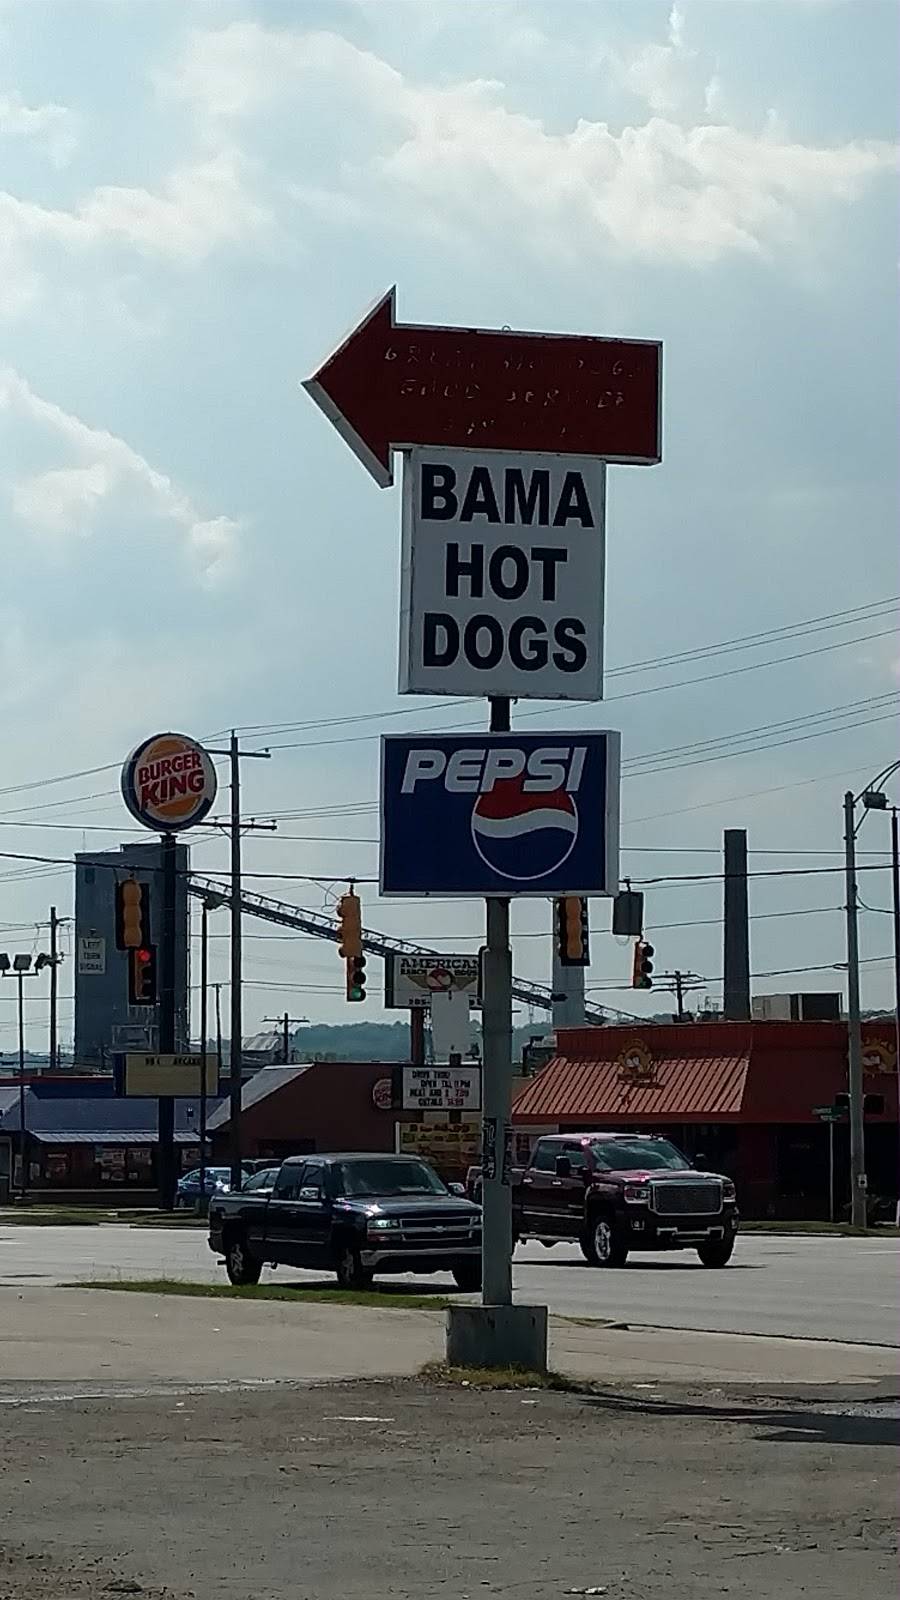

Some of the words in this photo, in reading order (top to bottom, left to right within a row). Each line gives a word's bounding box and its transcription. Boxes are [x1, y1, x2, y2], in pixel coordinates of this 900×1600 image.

[421, 463, 594, 528] BAMA
[446, 543, 568, 601] HOT
[423, 612, 587, 673] DOGS
[138, 751, 202, 786] BURGER
[140, 769, 205, 810] KING
[400, 747, 587, 794] PEPSI
